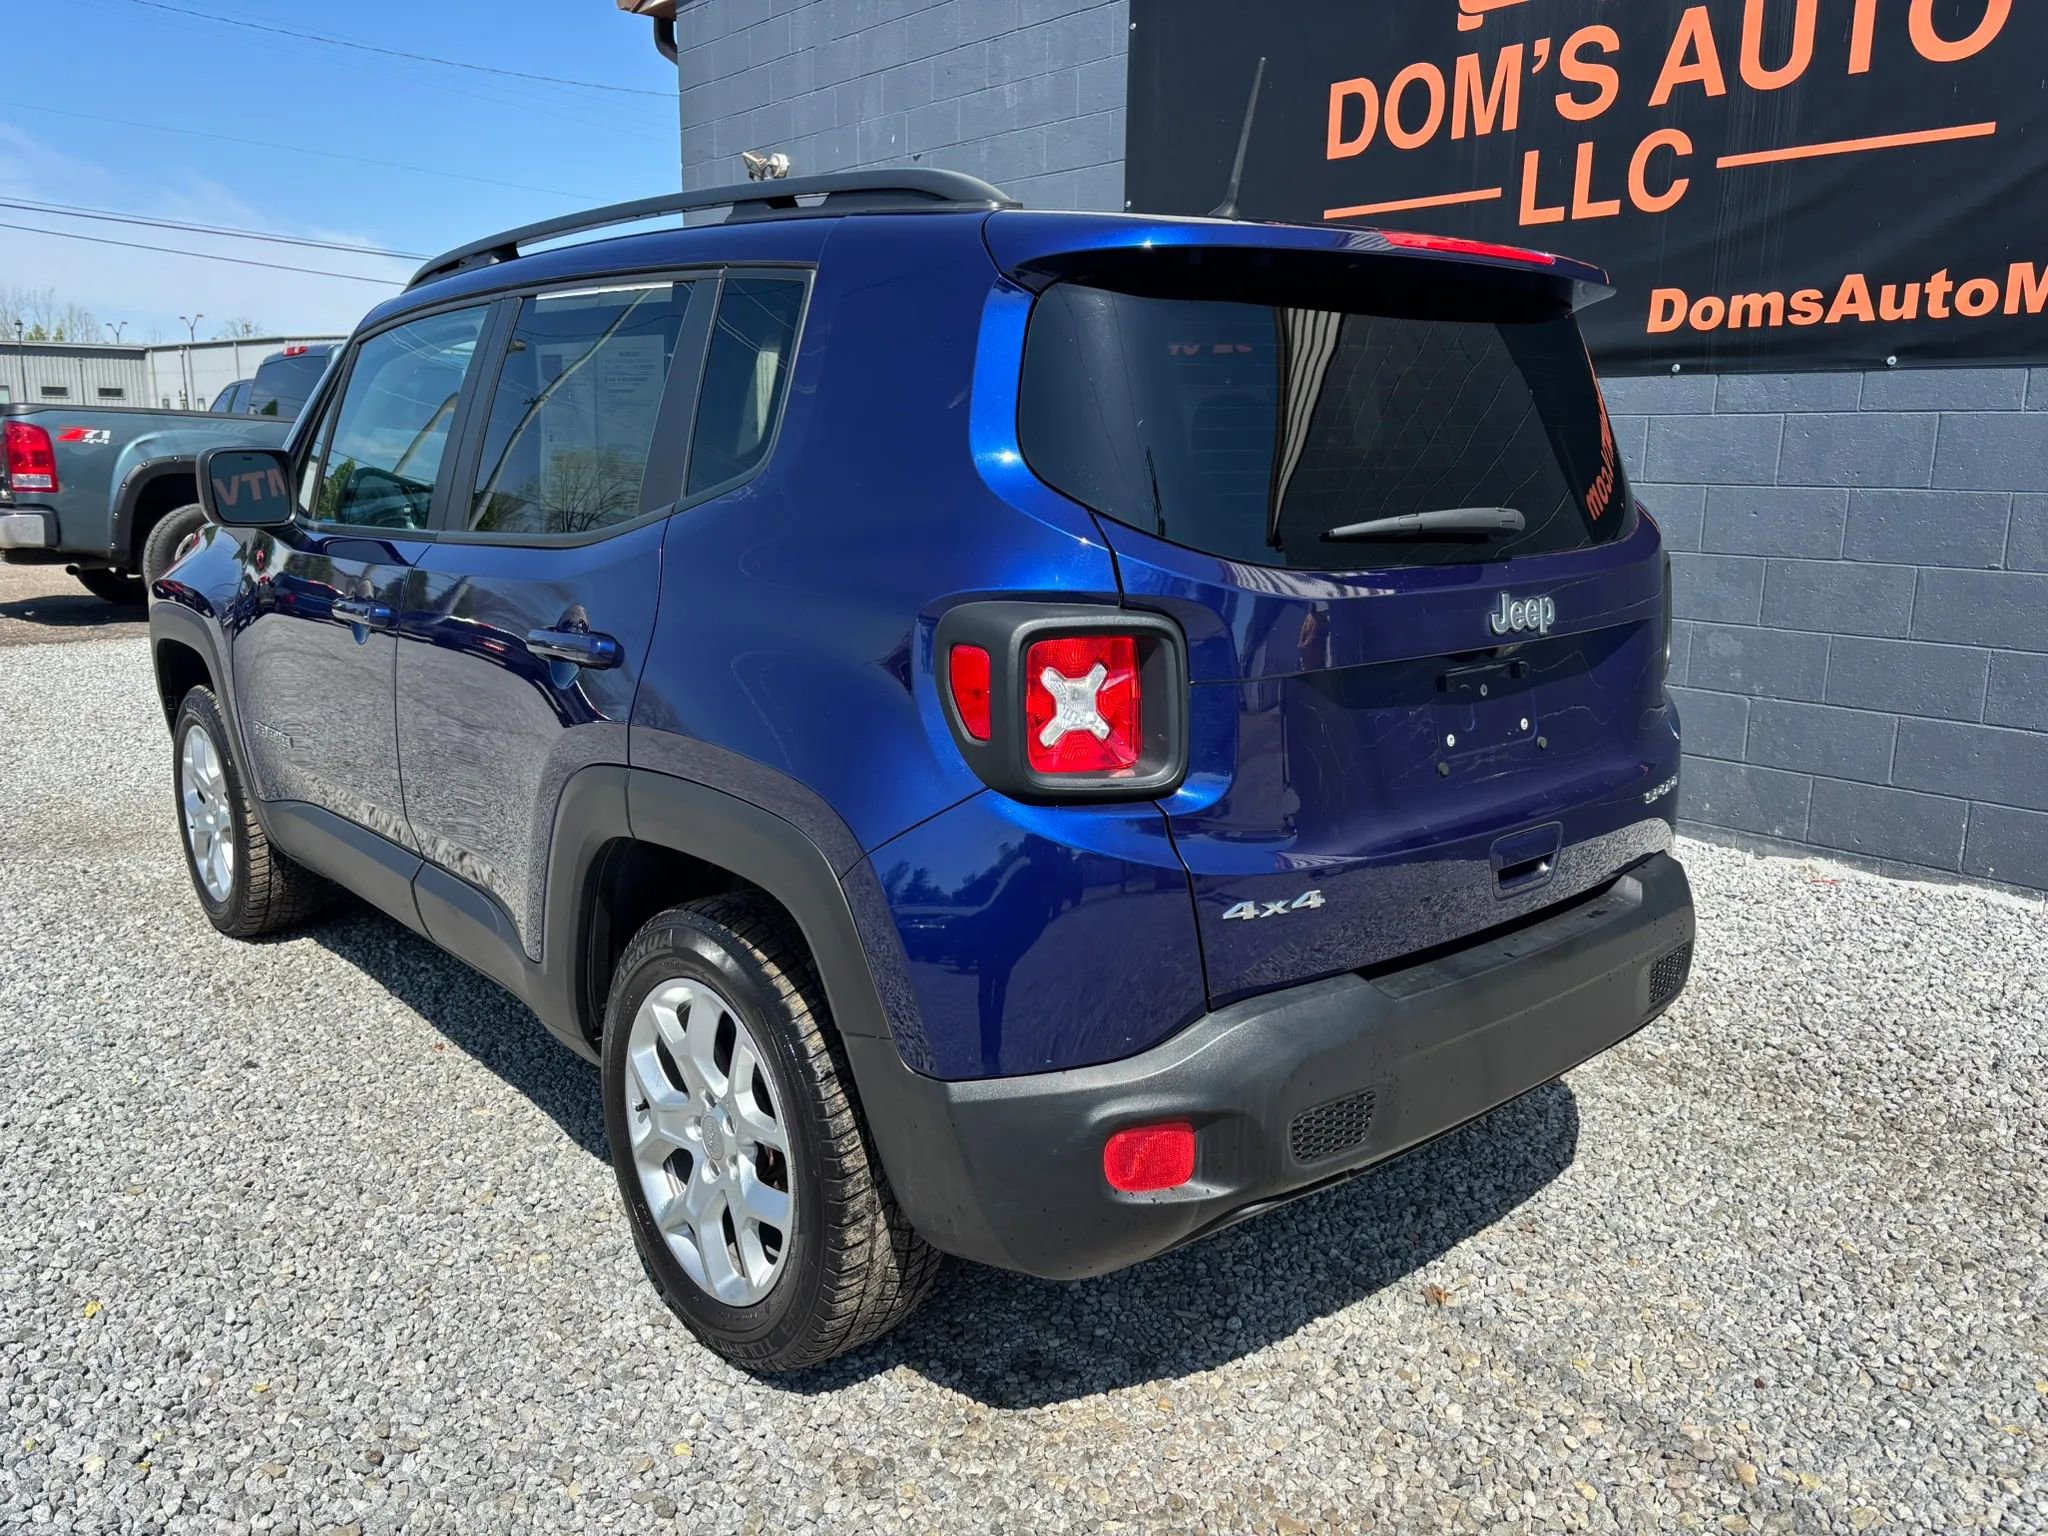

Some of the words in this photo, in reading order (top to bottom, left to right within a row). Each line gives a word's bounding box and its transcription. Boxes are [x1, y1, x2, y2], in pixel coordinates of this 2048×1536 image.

[1519, 129, 1693, 226] LLC
[1646, 262, 2048, 333] DomsAutoM
[56, 426, 111, 442] Z71
[1490, 592, 1556, 633] Jeep
[1222, 889, 1326, 920] 4x4
